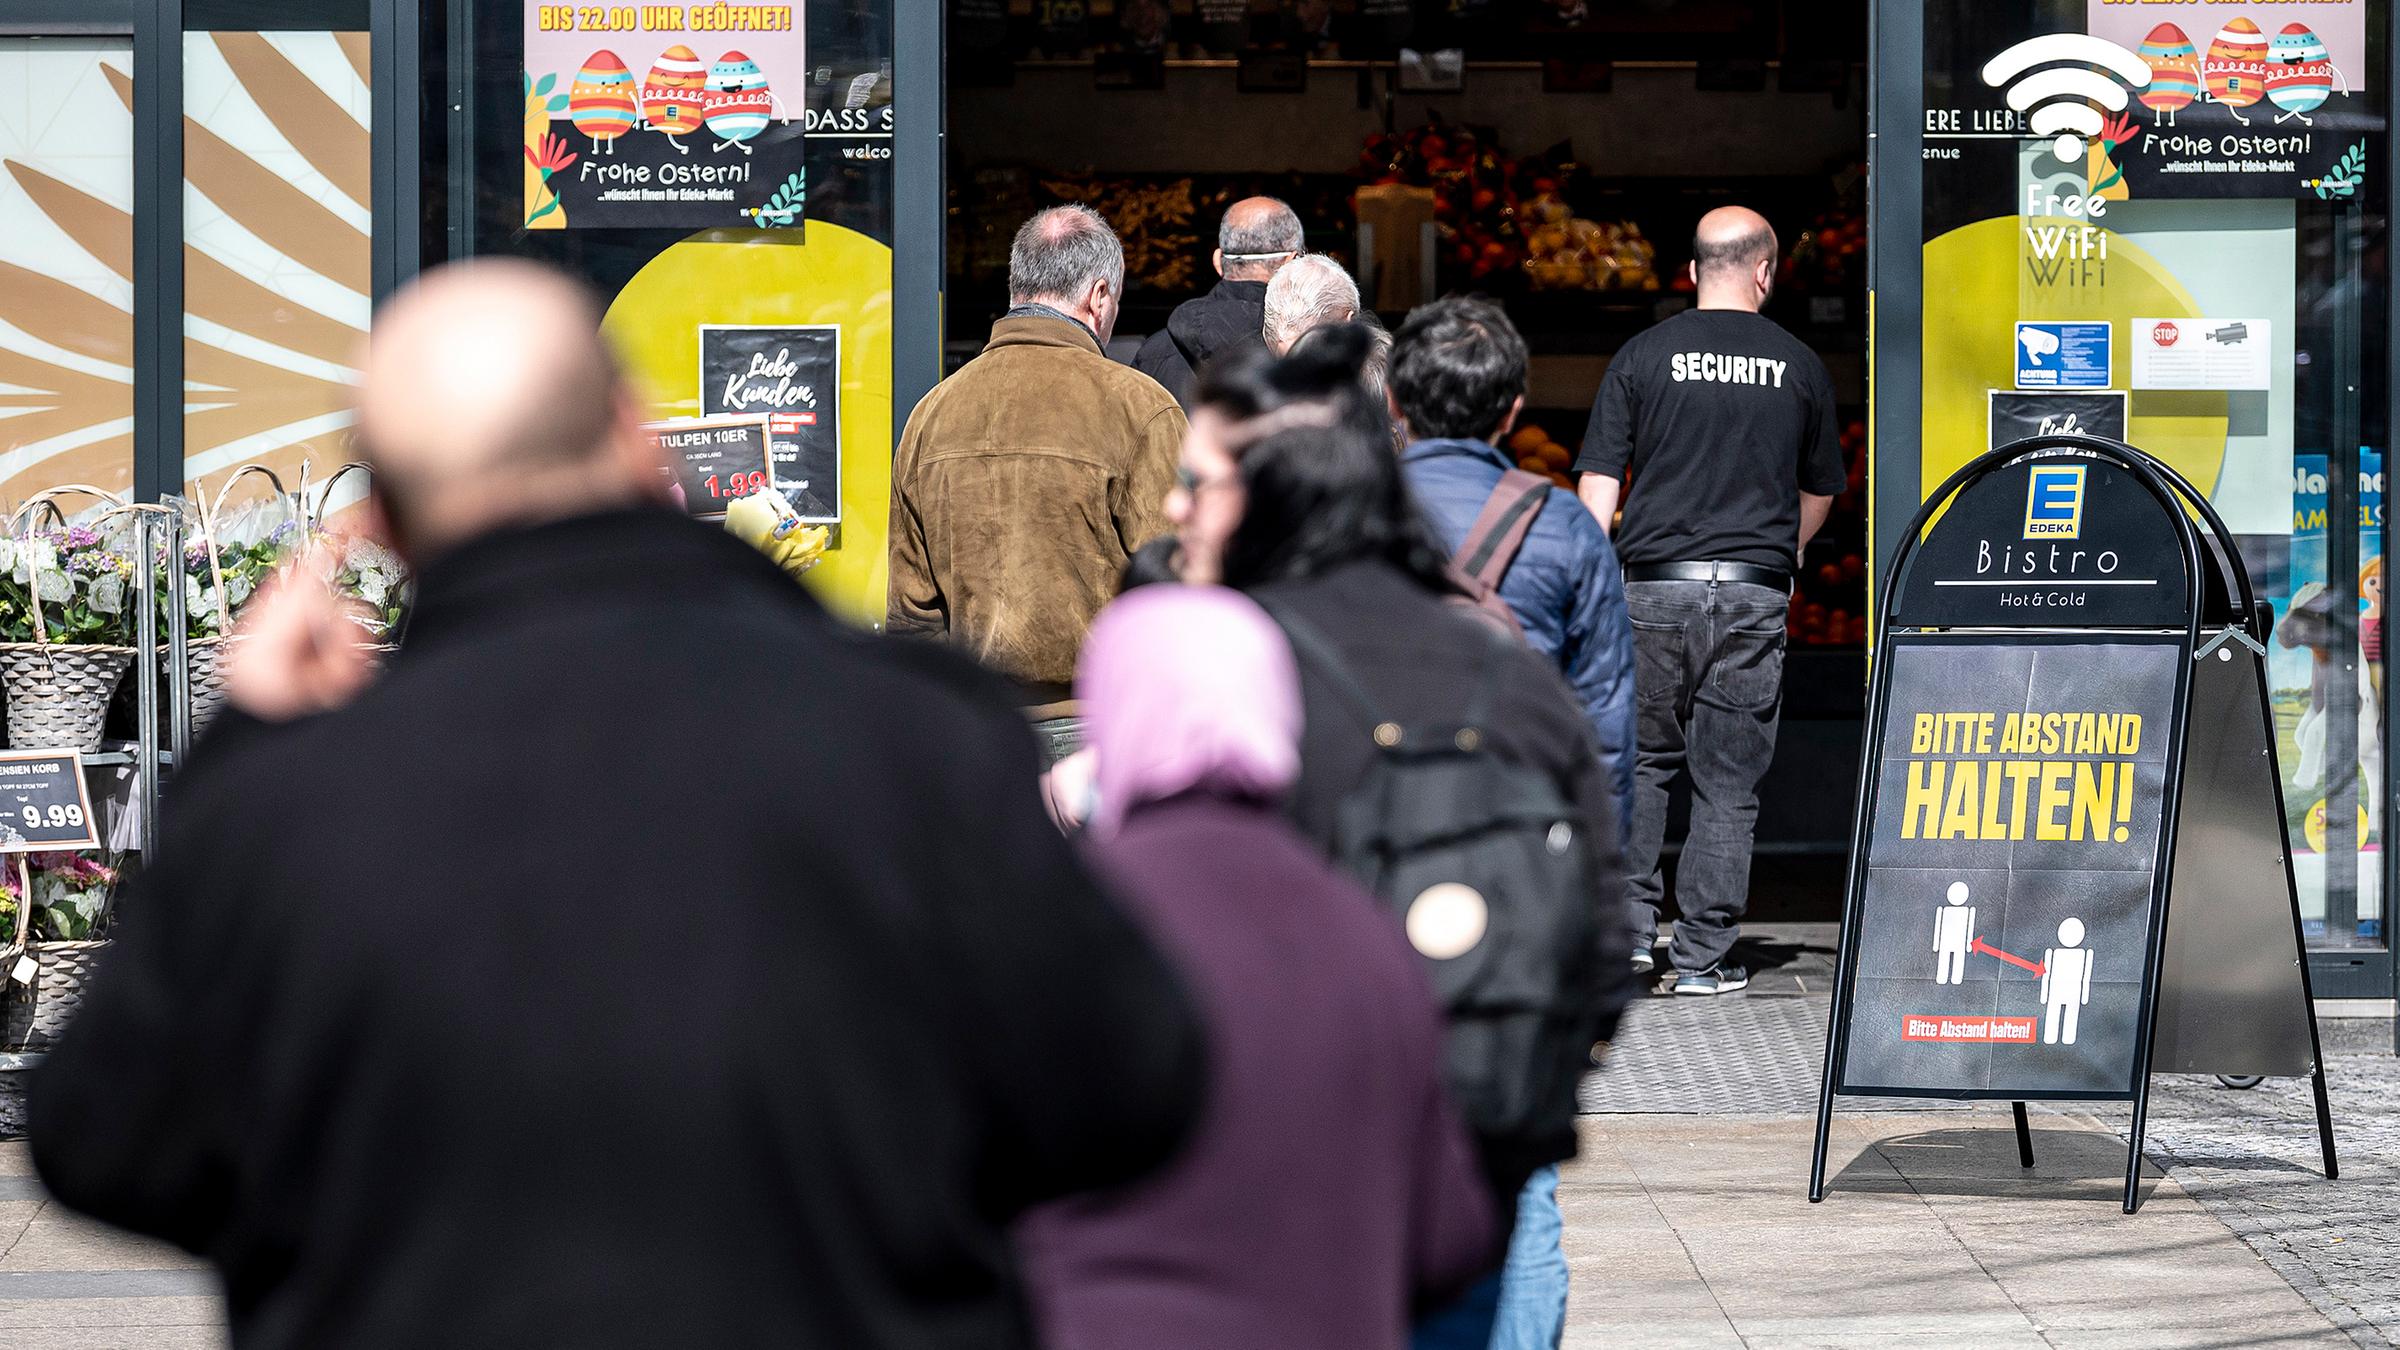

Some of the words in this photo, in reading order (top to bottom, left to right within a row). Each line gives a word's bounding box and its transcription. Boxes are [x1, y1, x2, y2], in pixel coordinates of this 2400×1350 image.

[539, 6, 573, 31] BIS
[577, 7, 636, 31] 22.00
[641, 7, 684, 31] UHR
[688, 2, 792, 31] GEÖFFNET!
[805, 109, 869, 131] DASS
[881, 109, 893, 131] S
[1926, 110, 1961, 131] ERE
[1974, 110, 2027, 131] LIEBE
[842, 143, 892, 159] welco
[2142, 133, 2213, 156] Frohe
[2220, 133, 2311, 156] Ostern!
[580, 161, 650, 184] Frohe
[658, 162, 750, 184] Ostern!
[2203, 160, 2227, 173] Ihnen
[2228, 160, 2240, 173] Ihr
[2241, 160, 2295, 173] Edeka-Markt
[641, 188, 665, 201] Ihnen
[666, 188, 679, 201] Ihr
[680, 188, 735, 201] Edeka-Markt
[2027, 184, 2107, 217] Free
[2025, 226, 2107, 260] WiFi
[2154, 328, 2178, 341] STOP
[746, 348, 799, 379] Liebe
[1671, 352, 1787, 388] SECURITY
[722, 374, 817, 410] Kunden,
[660, 432, 711, 448] TULPEN
[714, 429, 748, 444] 10ER
[704, 471, 768, 498] 1.99
[2029, 524, 2074, 533] EDEKA
[1976, 539, 2119, 574] Bistro
[1911, 713, 1996, 754] BITTE
[1999, 713, 2143, 755] ABSTAND
[31, 762, 60, 774] KORB
[1900, 760, 2136, 843] HALTEN!
[22, 803, 84, 829] 9.99
[1908, 1020, 1938, 1036] Bitte
[1940, 1020, 1987, 1037] Abstand
[1989, 1021, 2031, 1039] halten!
